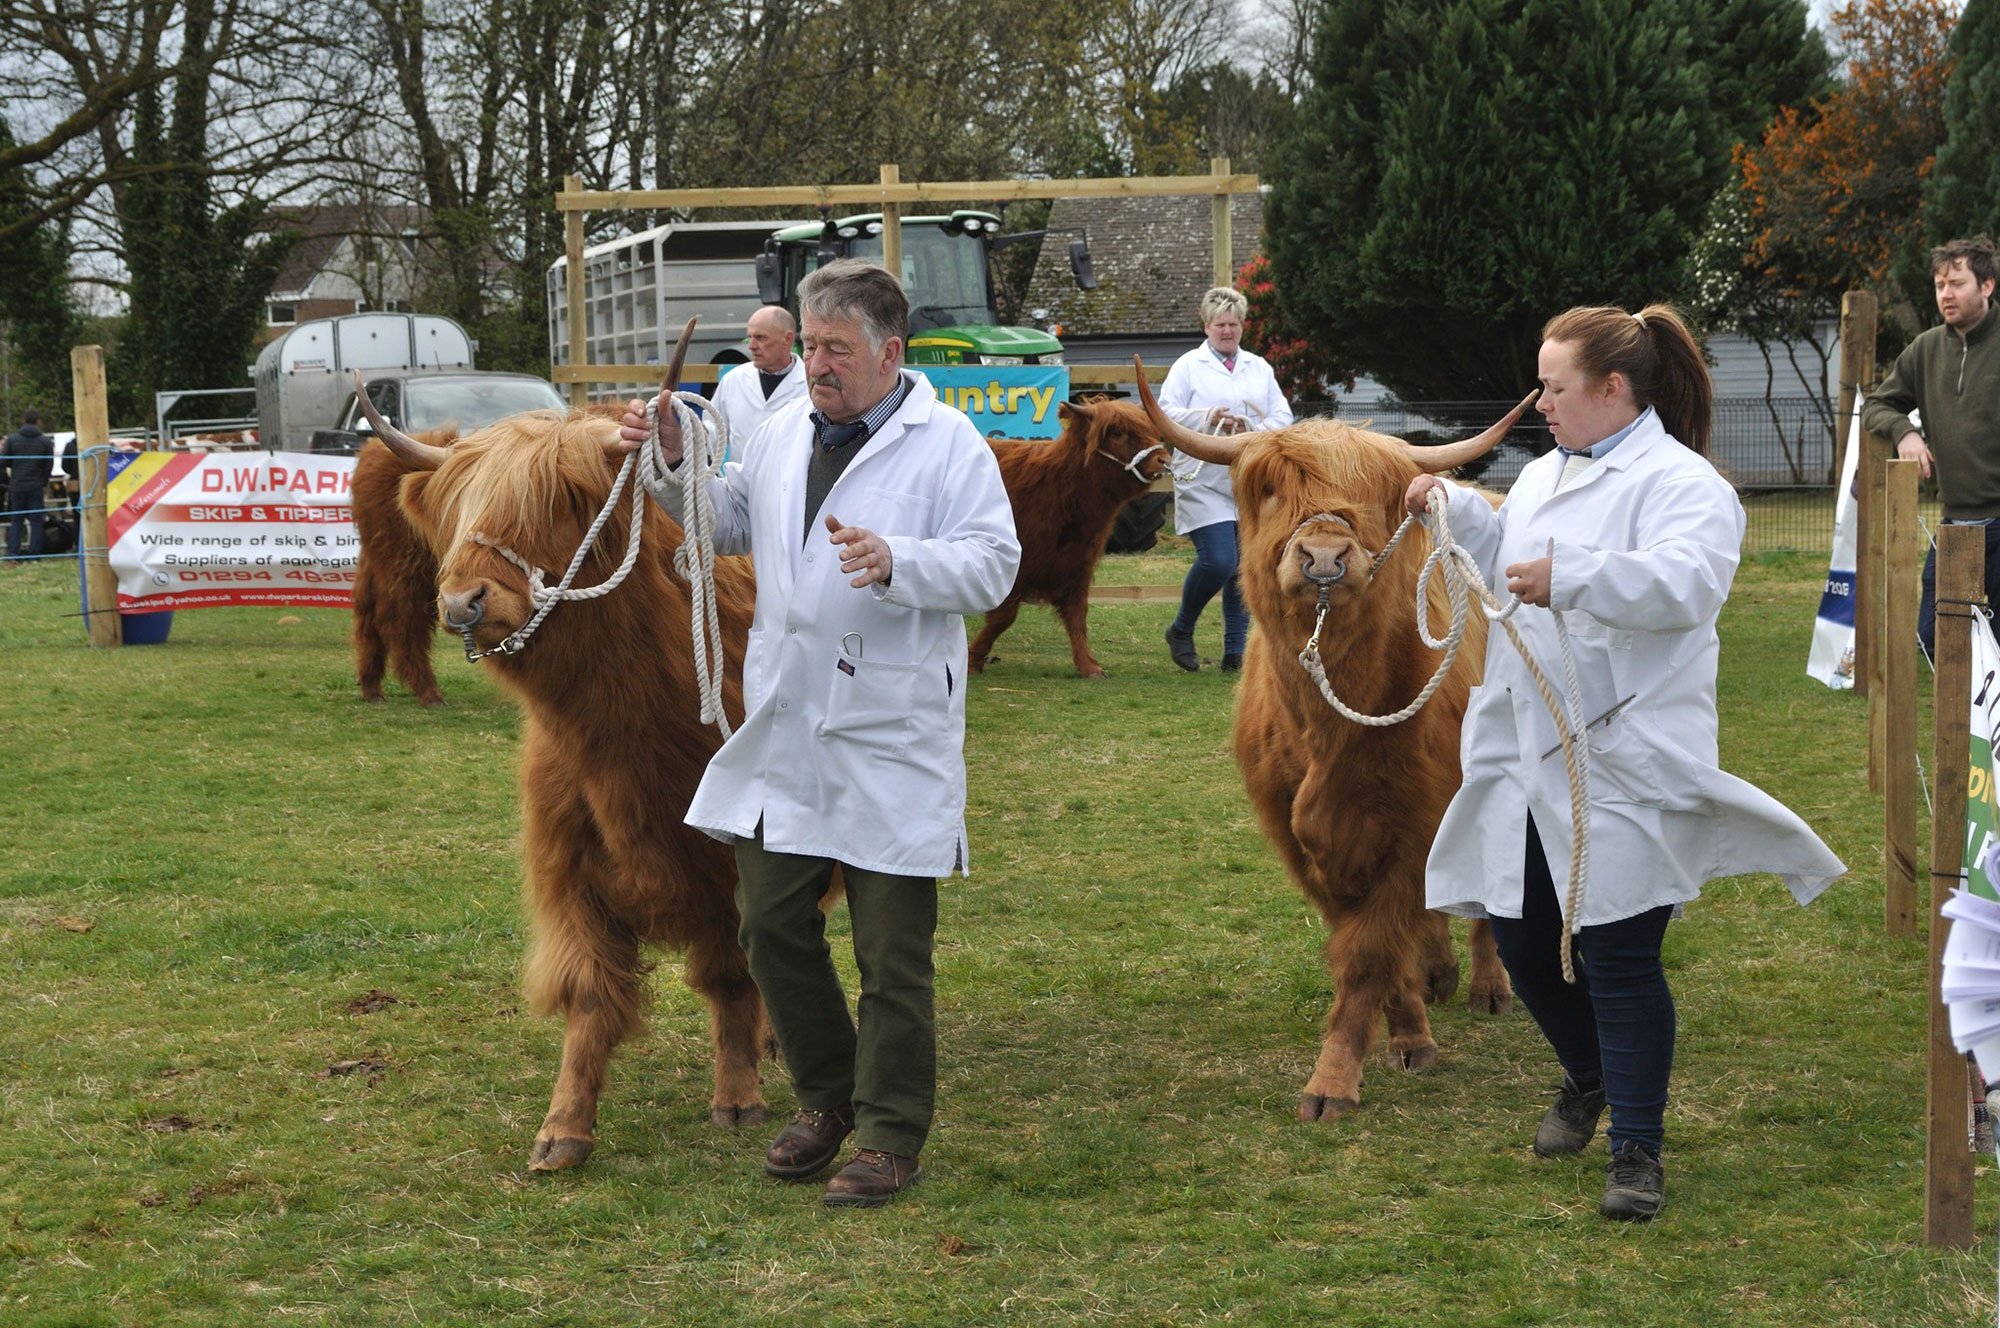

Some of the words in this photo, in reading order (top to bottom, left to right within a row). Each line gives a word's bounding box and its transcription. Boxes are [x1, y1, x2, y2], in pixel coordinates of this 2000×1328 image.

[189, 507, 242, 520] SKIP
[251, 507, 268, 520] &
[140, 534, 184, 546] Wide
[191, 537, 242, 548] range
[250, 535, 267, 546] of
[274, 535, 307, 547] skip
[314, 536, 328, 546] &
[164, 554, 247, 567] Suppliers
[256, 554, 273, 565] of
[178, 570, 272, 581] 01294
[240, 593, 353, 603] www.dwparkerskiphire.
